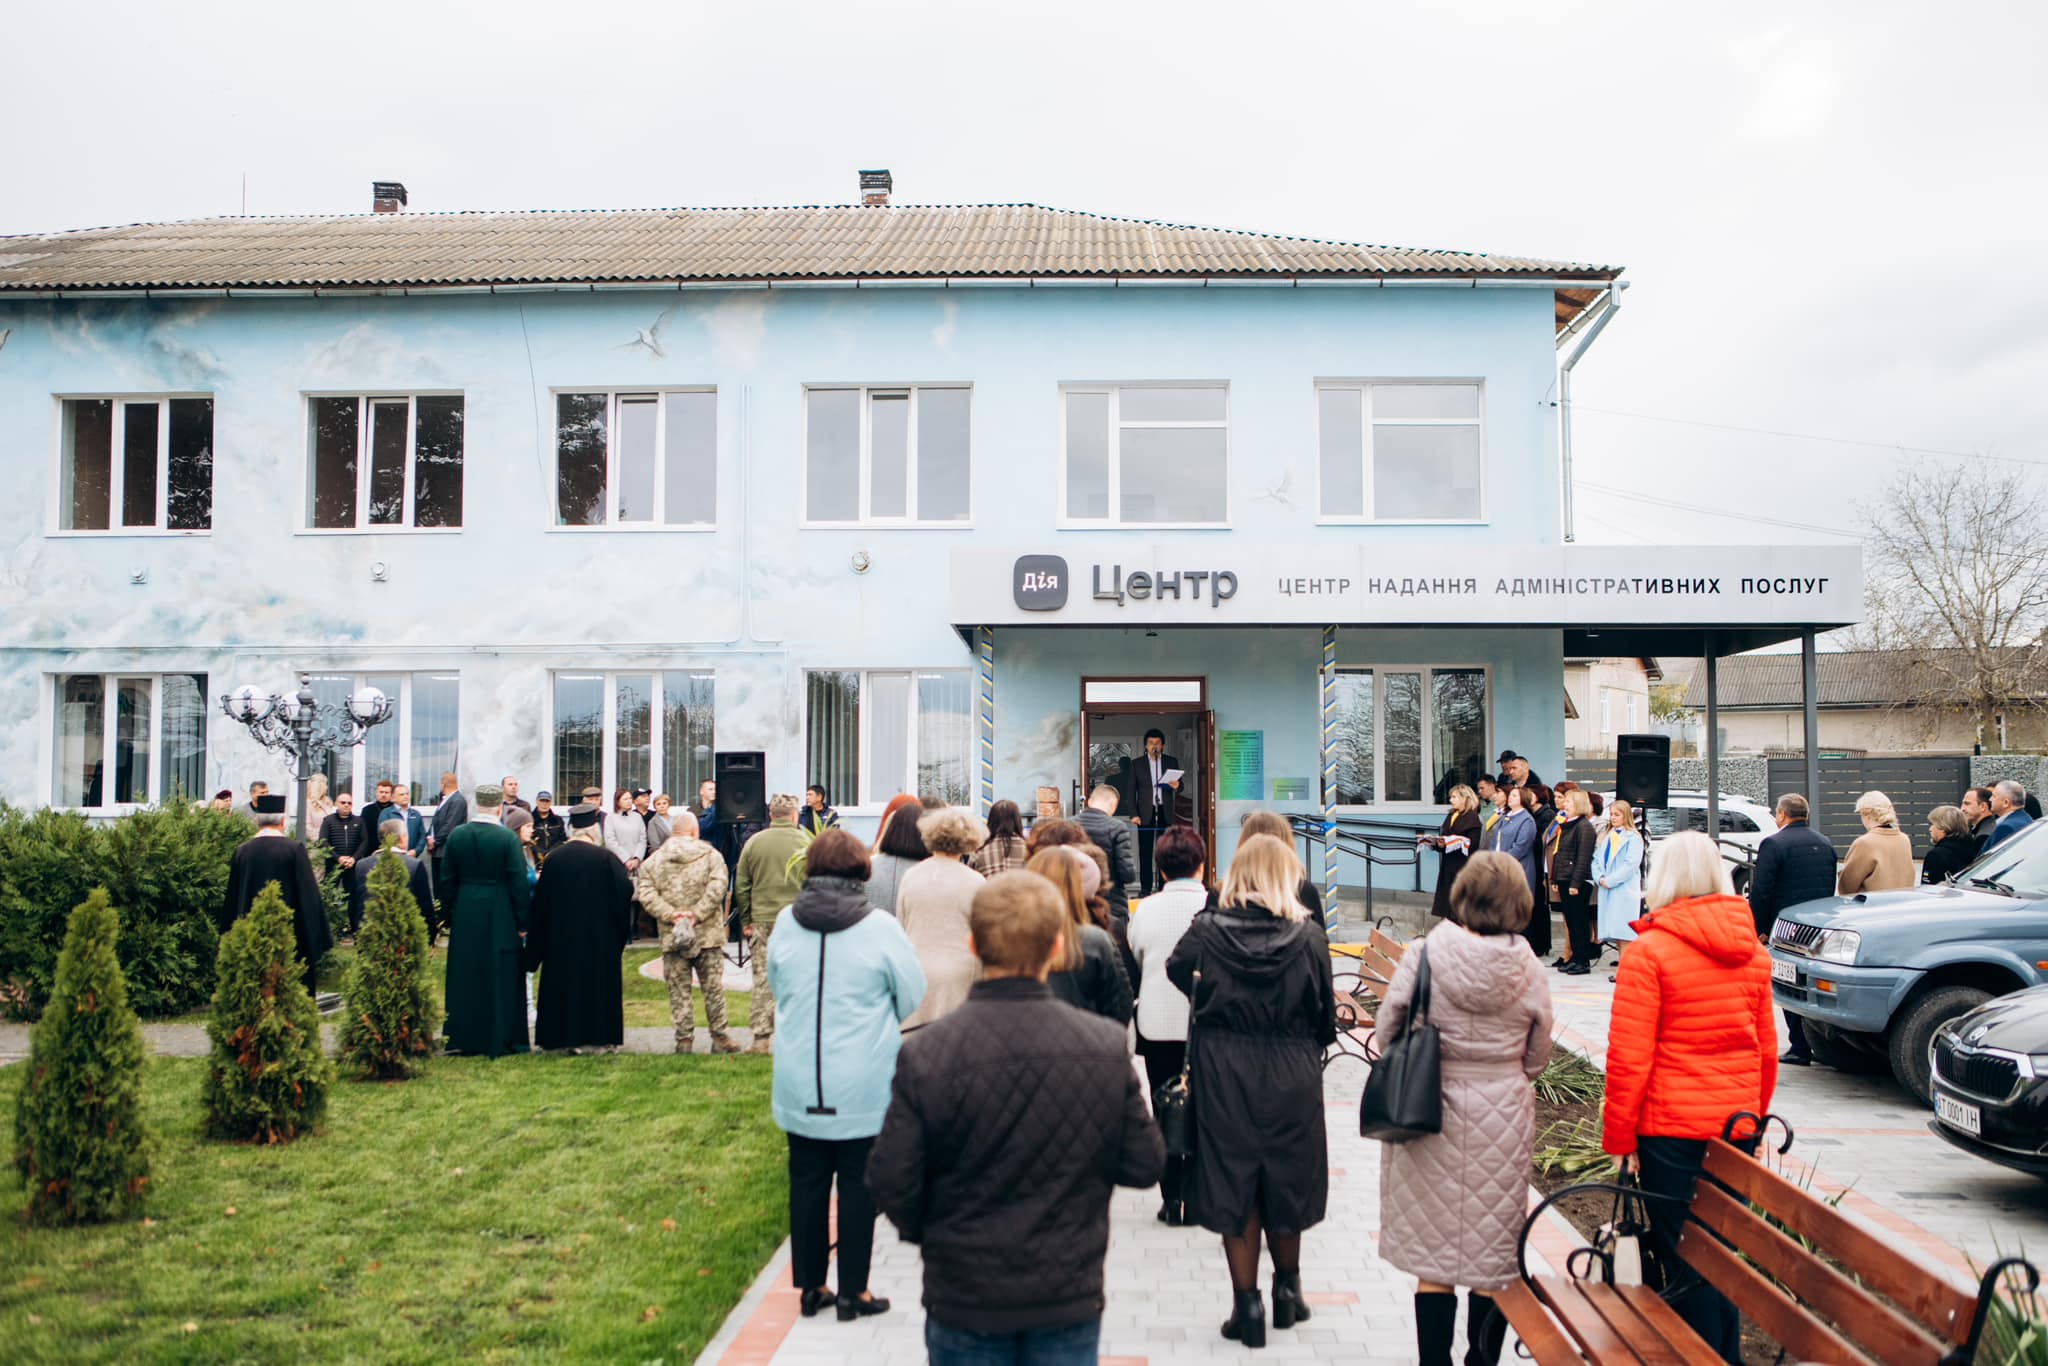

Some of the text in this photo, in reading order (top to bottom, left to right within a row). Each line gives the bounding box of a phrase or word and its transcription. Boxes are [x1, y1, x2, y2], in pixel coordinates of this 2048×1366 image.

[1022, 564, 1239, 608] Дія Центр
[1278, 577, 1829, 597] ЦЕНТР НАДАННЯ АДМІНІСТРАТИВНИХ ПОСЛУГ
[1947, 1101, 1964, 1124] 0001
